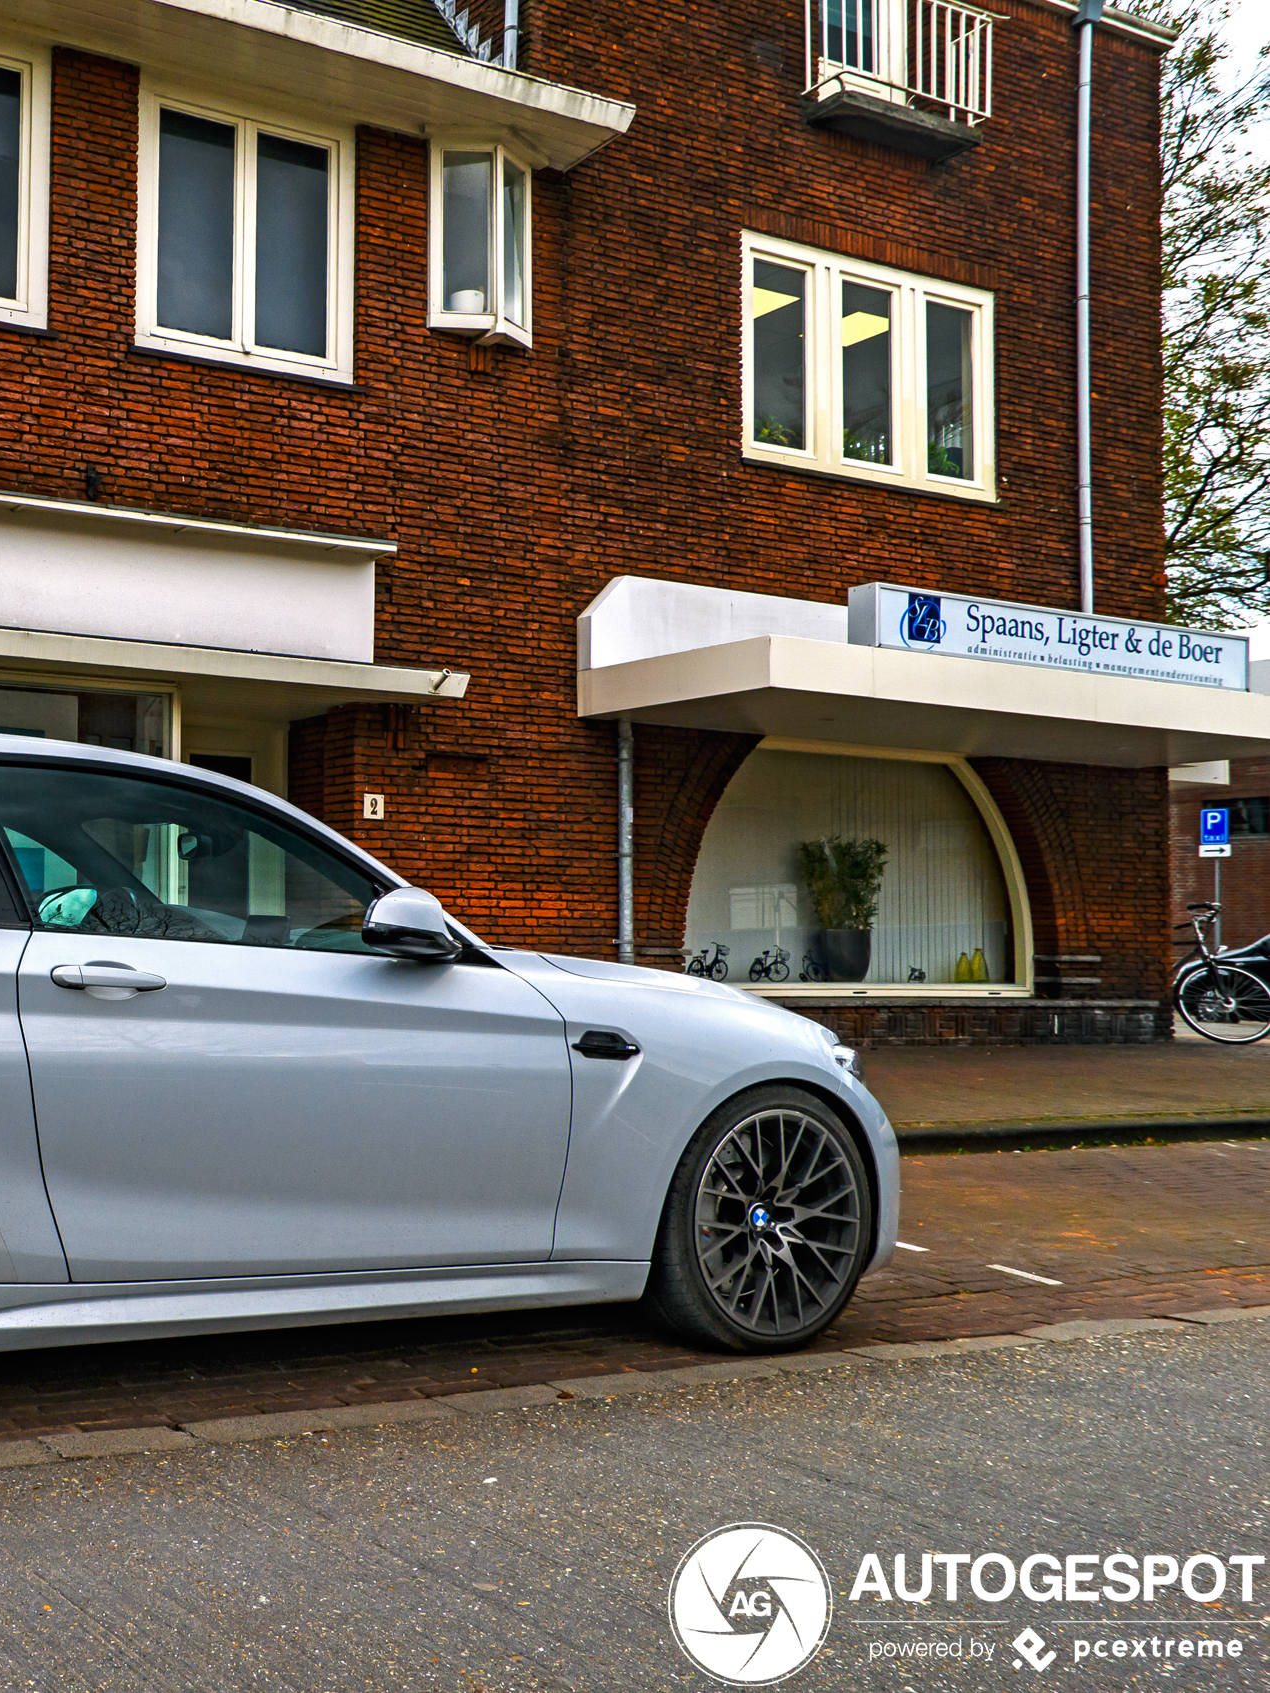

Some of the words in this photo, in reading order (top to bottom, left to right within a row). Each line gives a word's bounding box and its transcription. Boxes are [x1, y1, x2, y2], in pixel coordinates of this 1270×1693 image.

[966, 604, 1050, 646] Spaans,
[1057, 617, 1119, 656] Ligter
[1125, 627, 1143, 654] &
[1148, 630, 1173, 658] de
[1178, 634, 1223, 664] Boer
[967, 644, 1037, 662] administratie
[1047, 654, 1093, 670] belasting
[1103, 662, 1223, 686] managementondersteuning
[369, 797, 378, 816] 2
[1206, 812, 1222, 830] P
[1203, 834, 1225, 842] taxi
